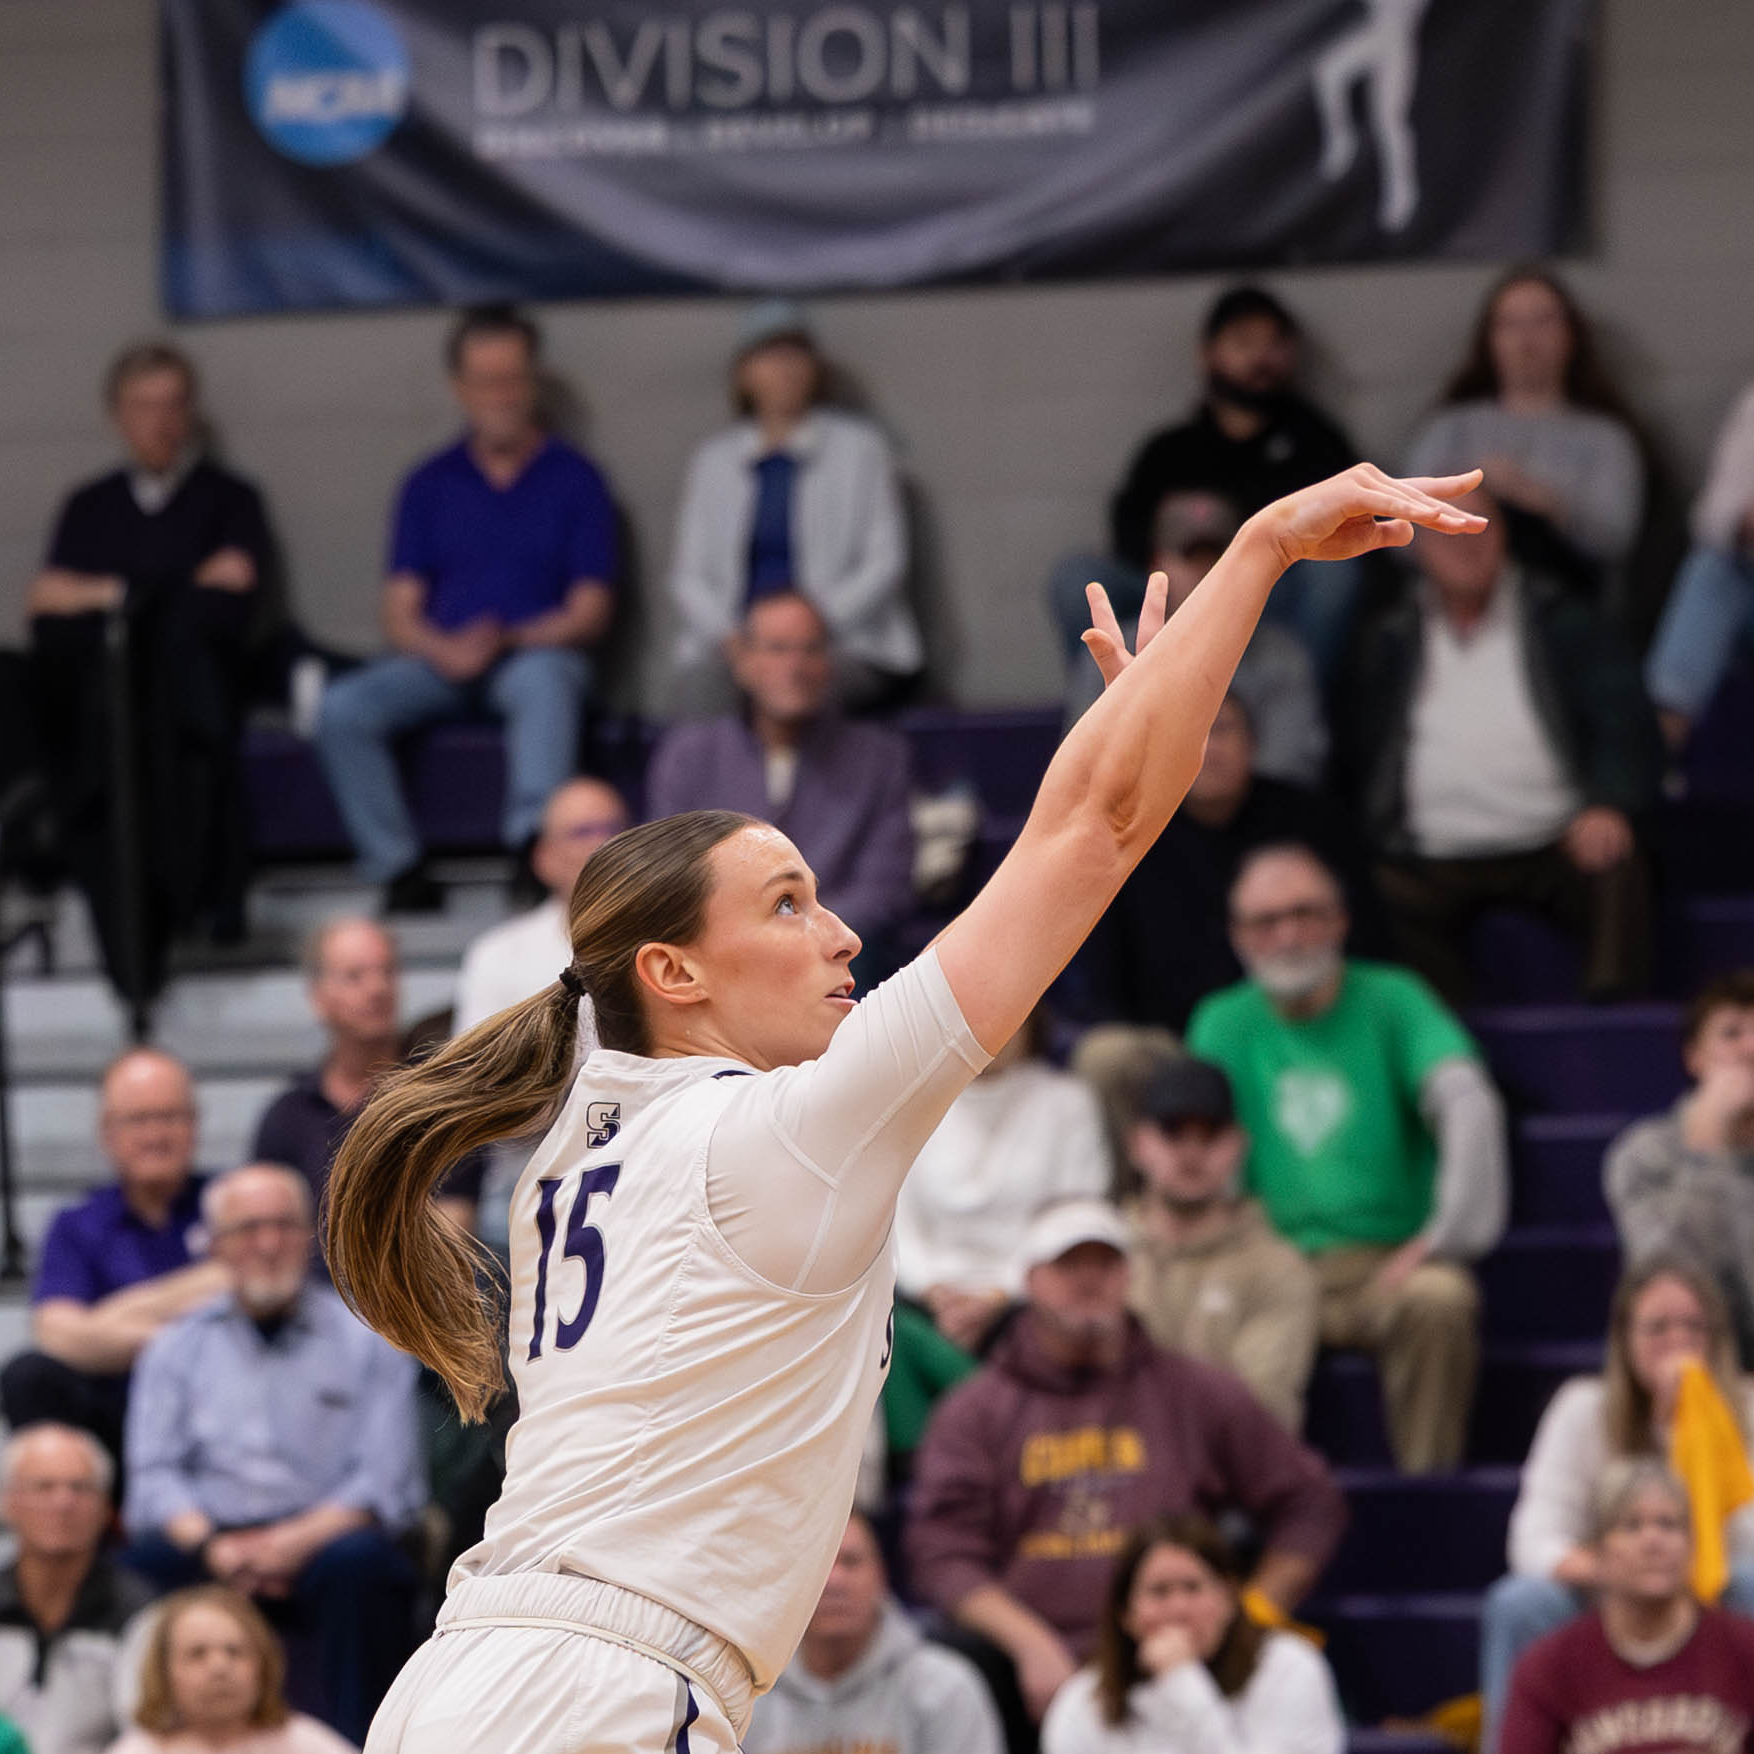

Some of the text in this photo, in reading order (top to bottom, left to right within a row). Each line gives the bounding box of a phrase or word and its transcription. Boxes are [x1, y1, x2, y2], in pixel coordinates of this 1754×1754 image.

[471, 6, 1099, 115] DIVISION III
[526, 1160, 623, 1364] 15
